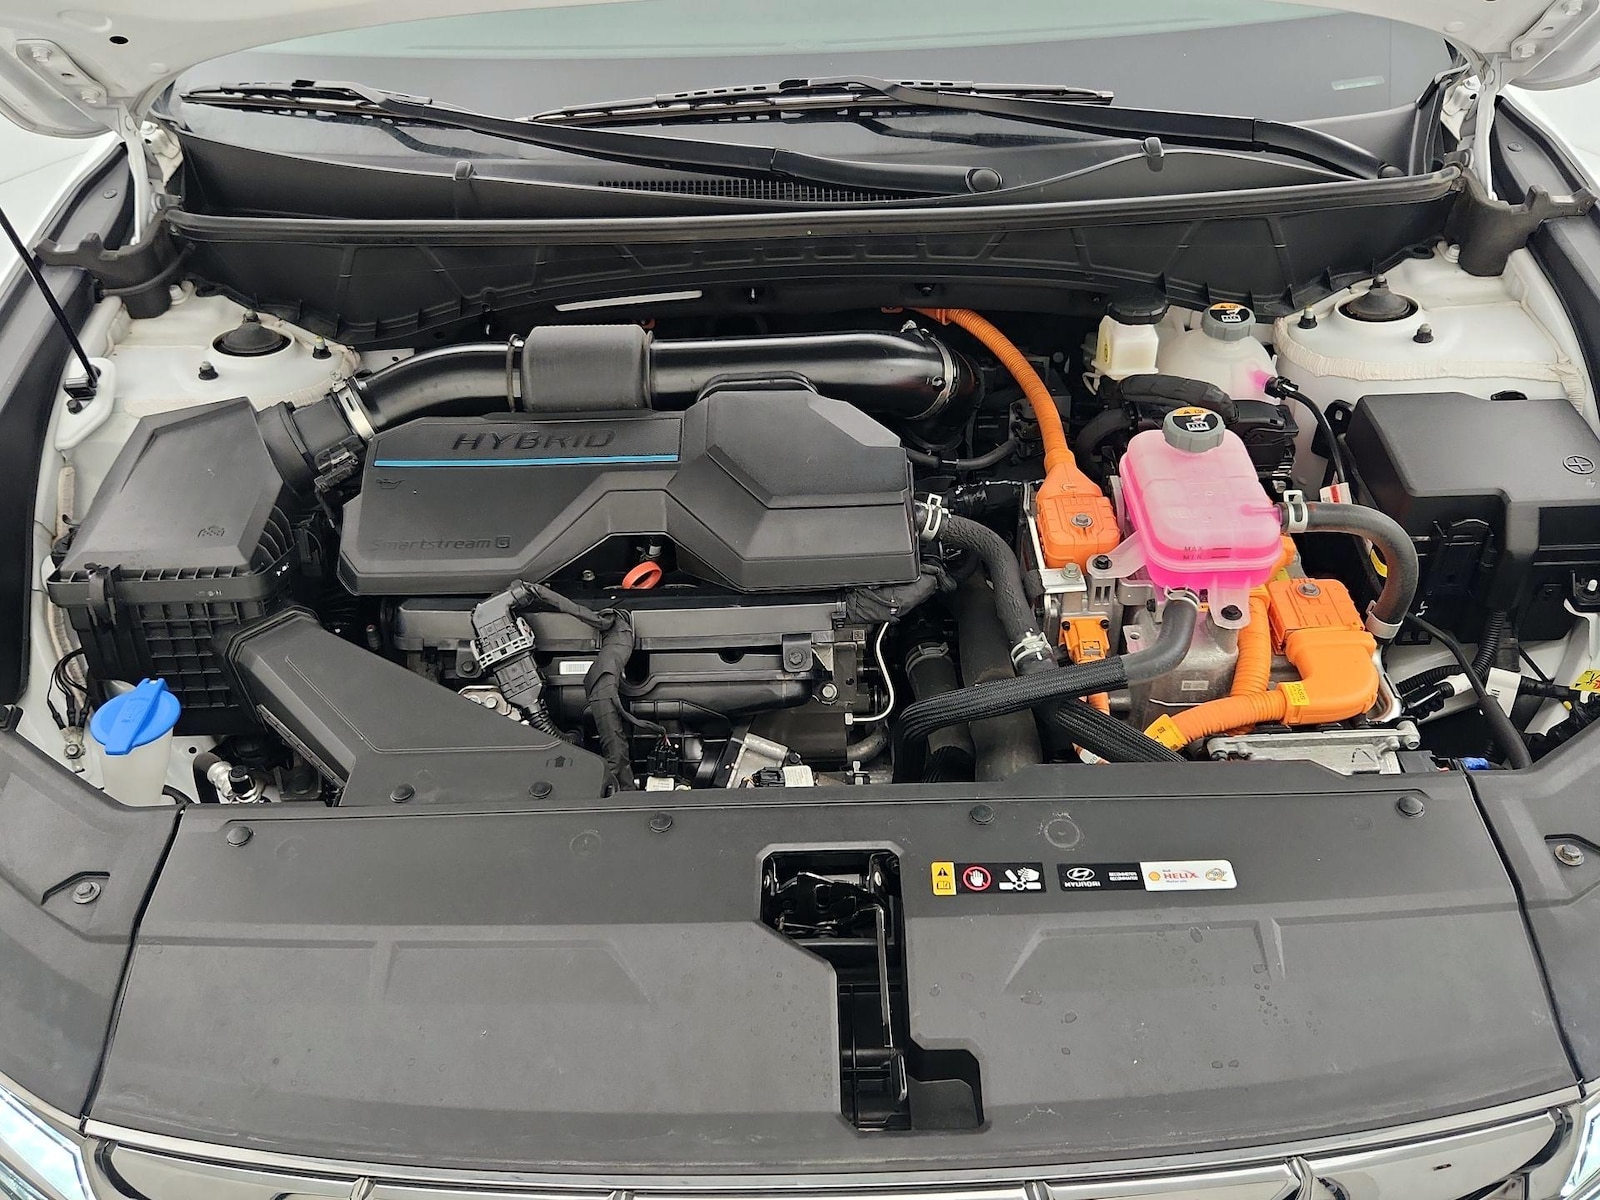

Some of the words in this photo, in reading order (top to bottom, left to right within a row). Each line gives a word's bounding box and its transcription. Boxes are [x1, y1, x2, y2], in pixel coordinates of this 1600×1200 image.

[452, 429, 617, 450] HYBRID
[373, 537, 494, 550] Smartstream
[1163, 871, 1200, 880] HELIX
